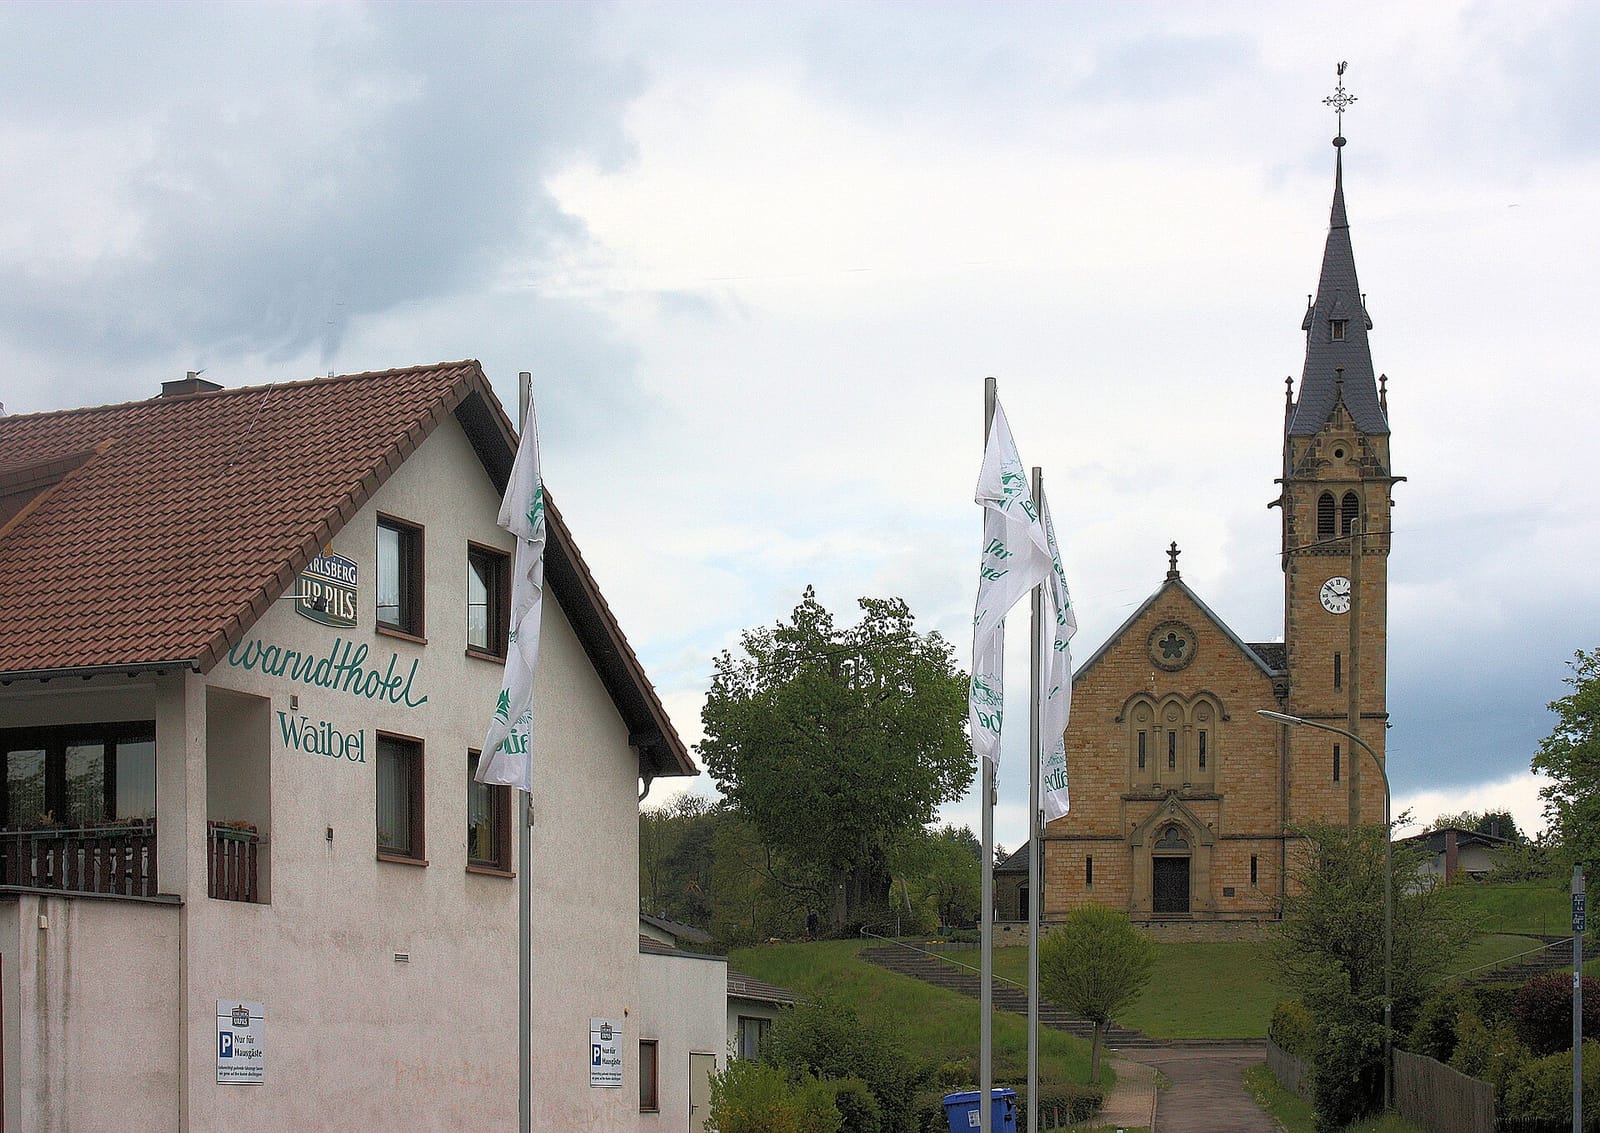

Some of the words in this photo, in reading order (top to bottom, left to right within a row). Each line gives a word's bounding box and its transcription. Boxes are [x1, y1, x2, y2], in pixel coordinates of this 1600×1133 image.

[305, 557, 357, 584] ARLSBERG
[276, 710, 367, 763] Waibel
[234, 1035, 245, 1044] Nur
